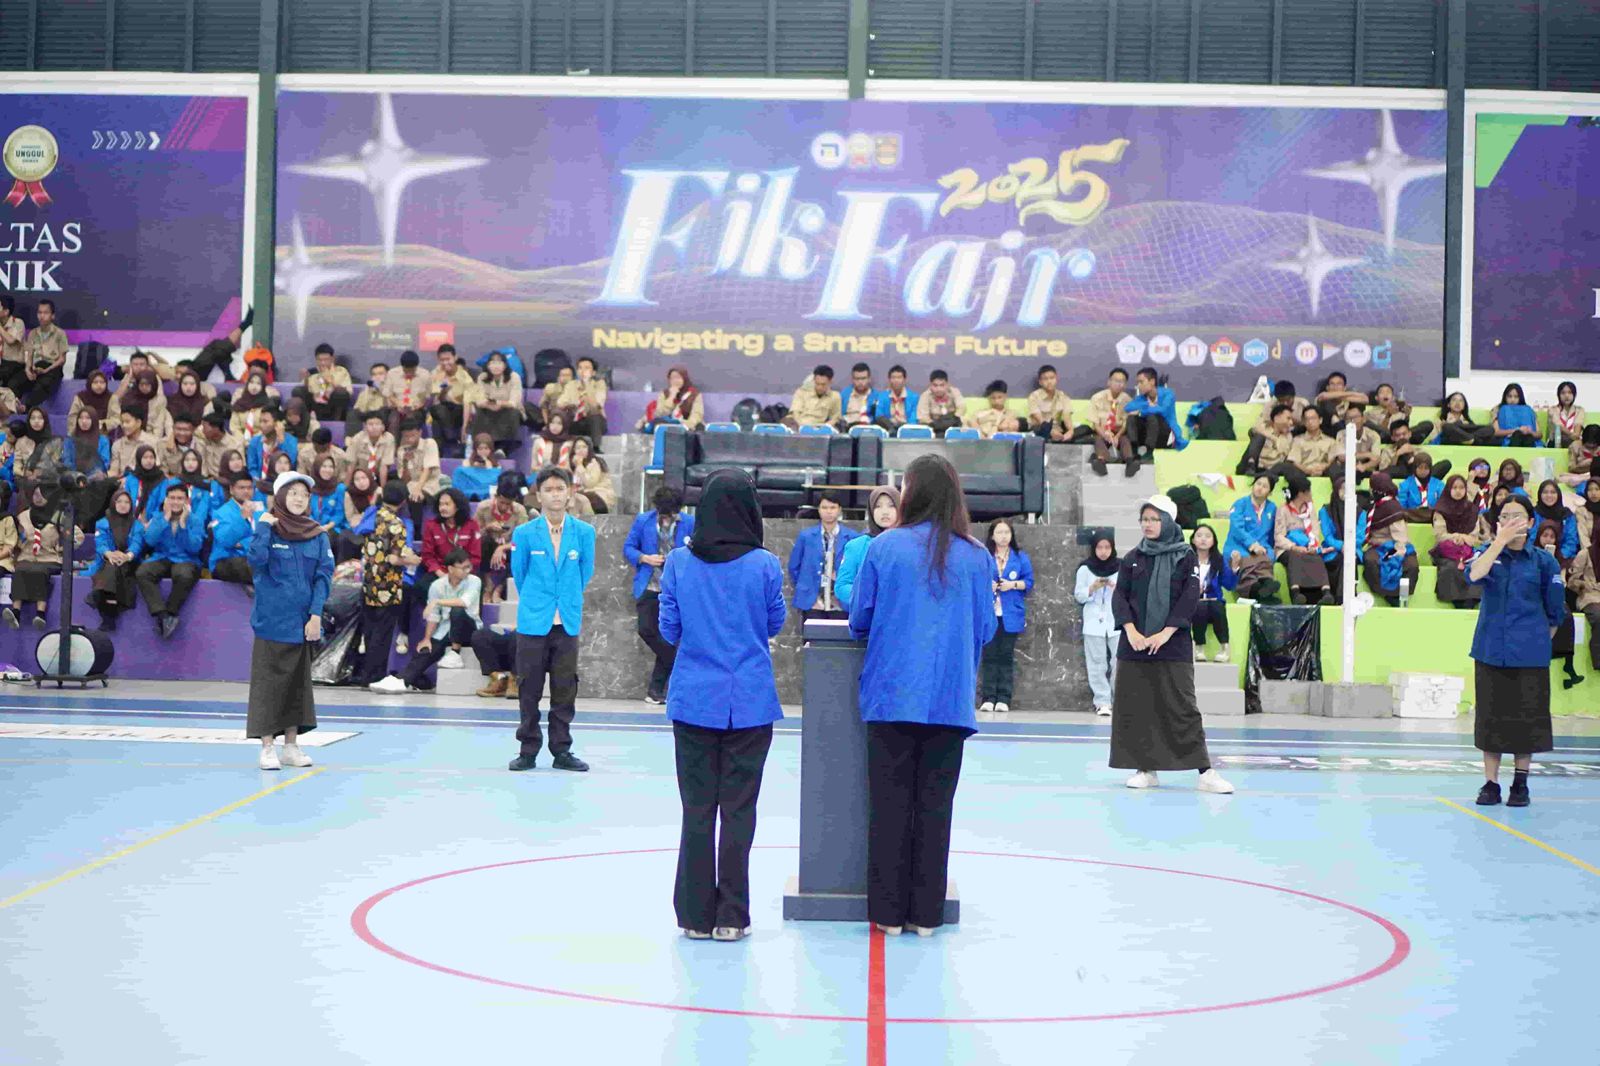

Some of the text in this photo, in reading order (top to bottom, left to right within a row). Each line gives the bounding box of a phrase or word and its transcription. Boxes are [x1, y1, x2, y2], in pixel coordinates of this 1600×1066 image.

[937, 137, 1130, 225] 2025
[586, 166, 826, 306] Fik
[592, 327, 1068, 357] Navigating a Smarter Future
